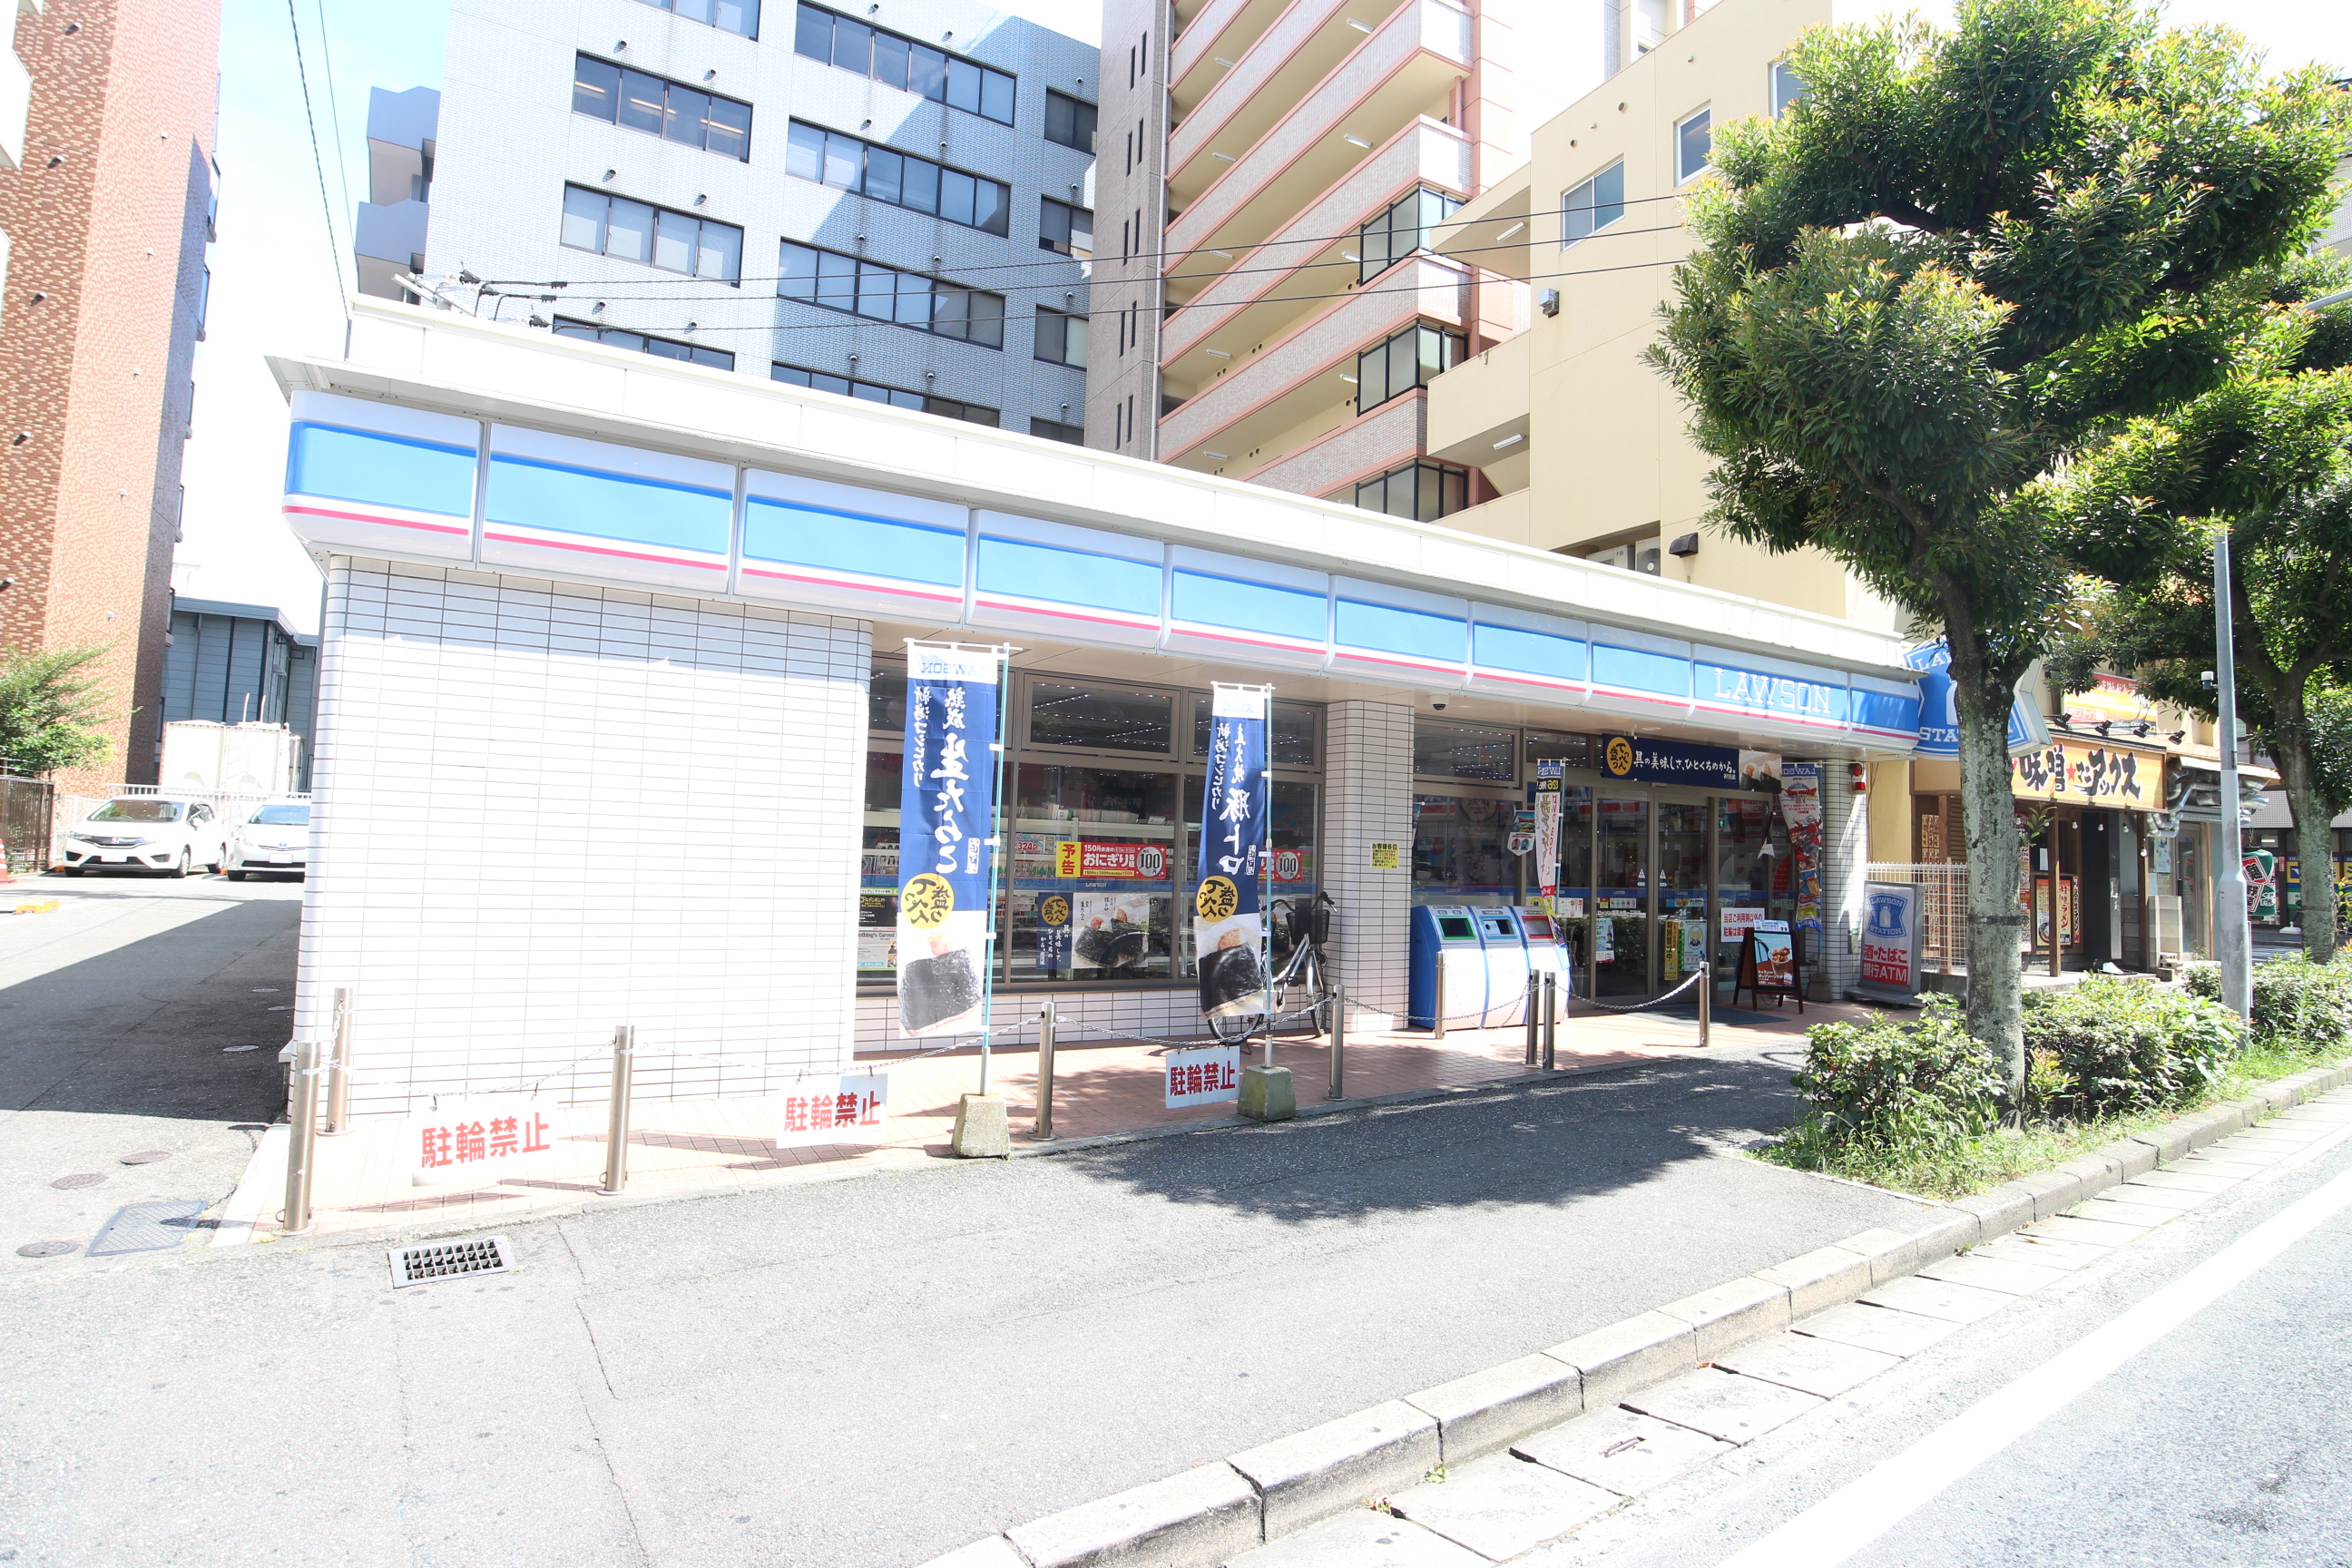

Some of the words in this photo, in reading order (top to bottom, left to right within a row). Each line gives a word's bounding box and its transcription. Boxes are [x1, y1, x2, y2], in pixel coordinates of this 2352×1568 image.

[1714, 667, 1832, 715] LAWSON
[1062, 844, 1075, 875] 予告
[1083, 853, 1129, 867] おにぎり
[1140, 853, 1161, 869] 100
[1279, 858, 1297, 872] 100
[1870, 897, 1904, 907] LAWSON
[1869, 926, 1902, 936] STATION
[1863, 963, 1907, 982] 銀行ATM
[1170, 1060, 1237, 1096] 駐輪禁止
[784, 1089, 881, 1132] 駐輪禁止
[421, 1111, 551, 1168] 駐輪禁止
